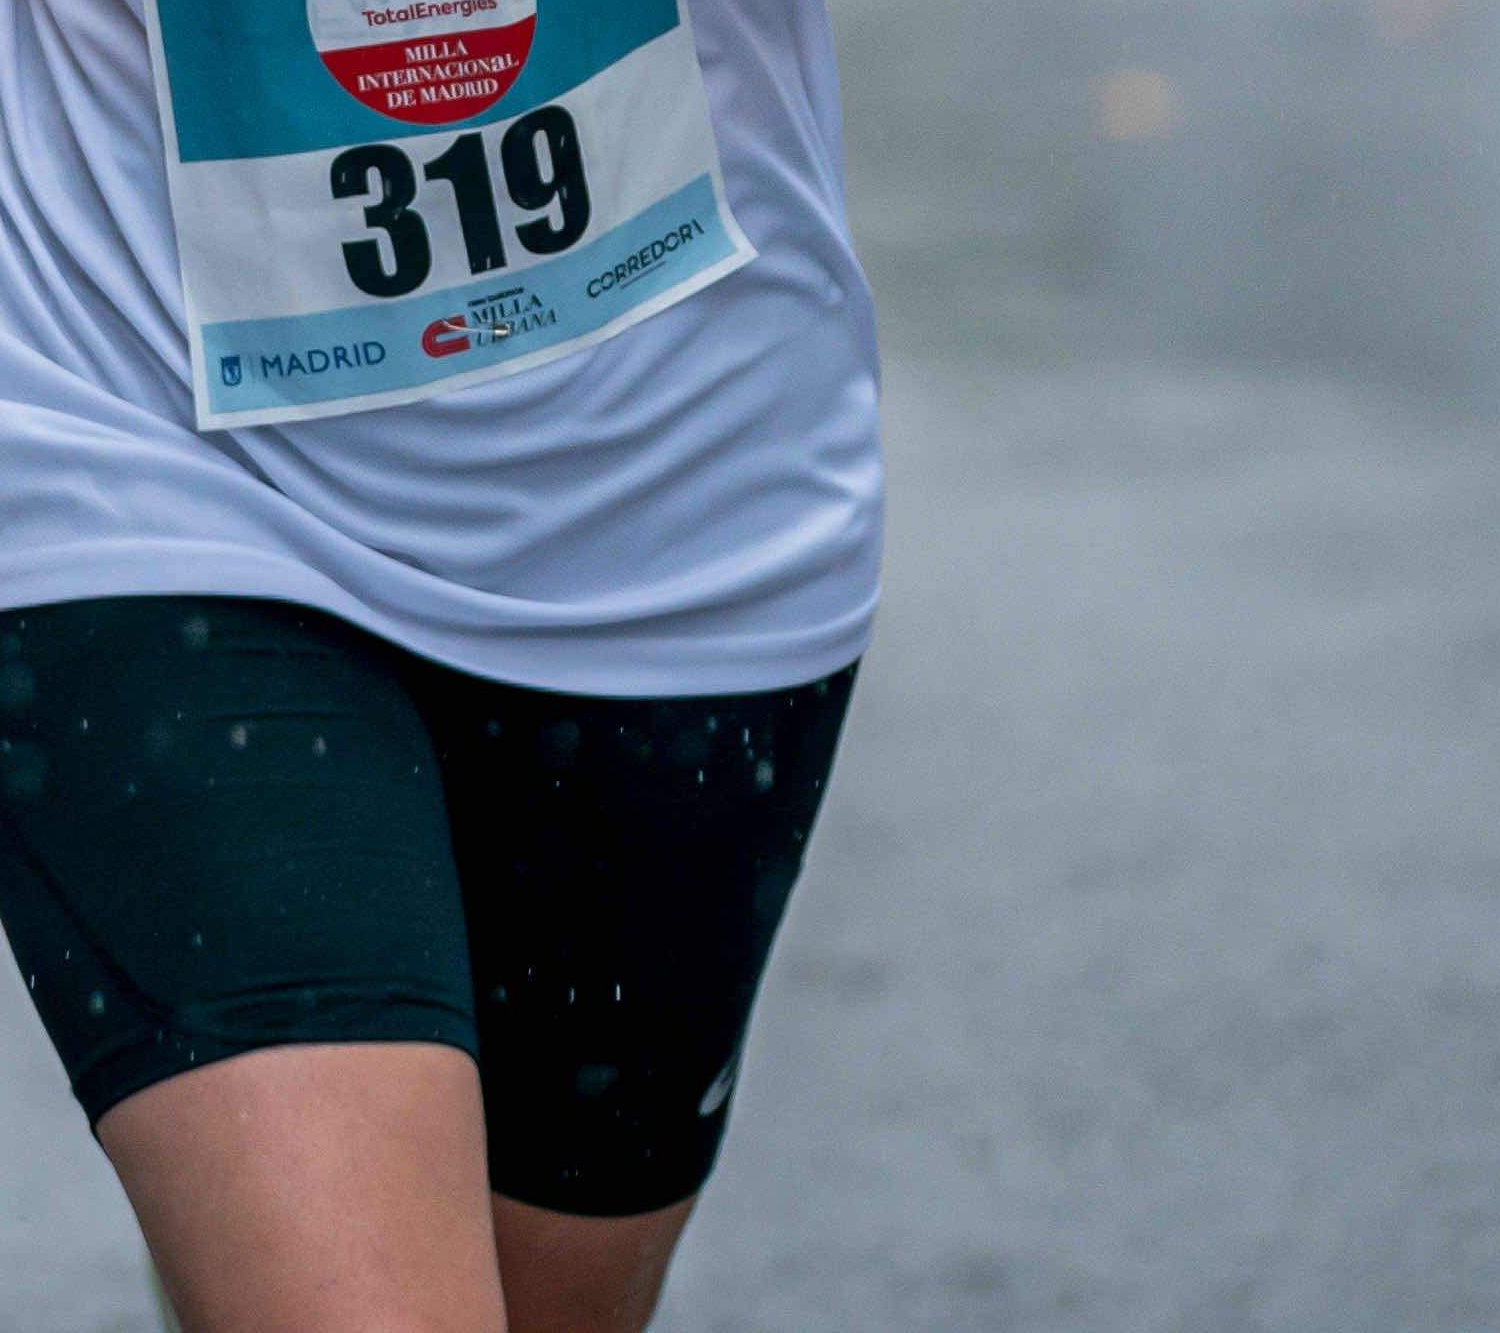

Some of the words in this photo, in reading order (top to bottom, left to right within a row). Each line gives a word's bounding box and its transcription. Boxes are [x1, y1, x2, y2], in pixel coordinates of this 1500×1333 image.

[404, 38, 469, 63] MILLA
[386, 89, 417, 110] DE
[419, 78, 500, 105] MADRID
[329, 104, 593, 299] 319
[472, 293, 542, 324] MILLA
[260, 340, 387, 379] MADRID
